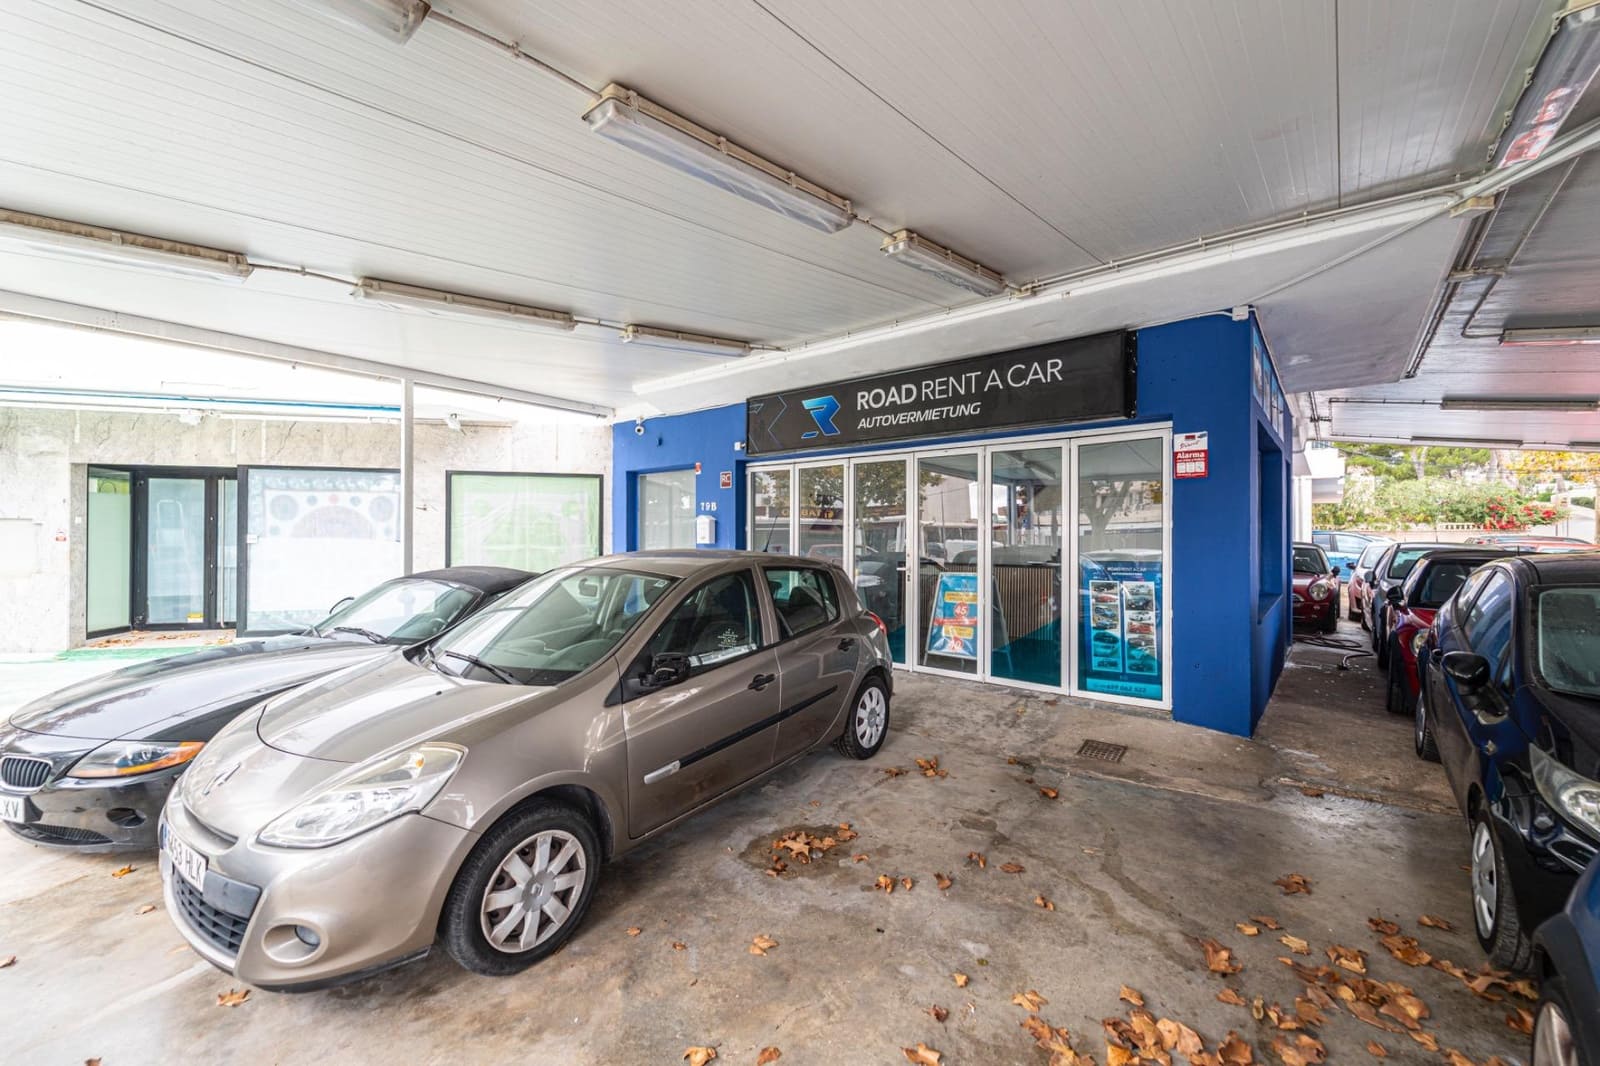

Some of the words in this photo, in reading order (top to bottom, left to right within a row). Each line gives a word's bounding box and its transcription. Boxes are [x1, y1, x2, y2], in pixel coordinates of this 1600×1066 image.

[857, 383, 917, 410] ROAD
[922, 371, 982, 401] RENT
[984, 365, 1004, 392] A
[1007, 358, 1063, 387] CAR
[857, 402, 981, 429] AUTOVERMIETUNG
[1177, 451, 1205, 459] Alarma
[0, 799, 20, 819] XV
